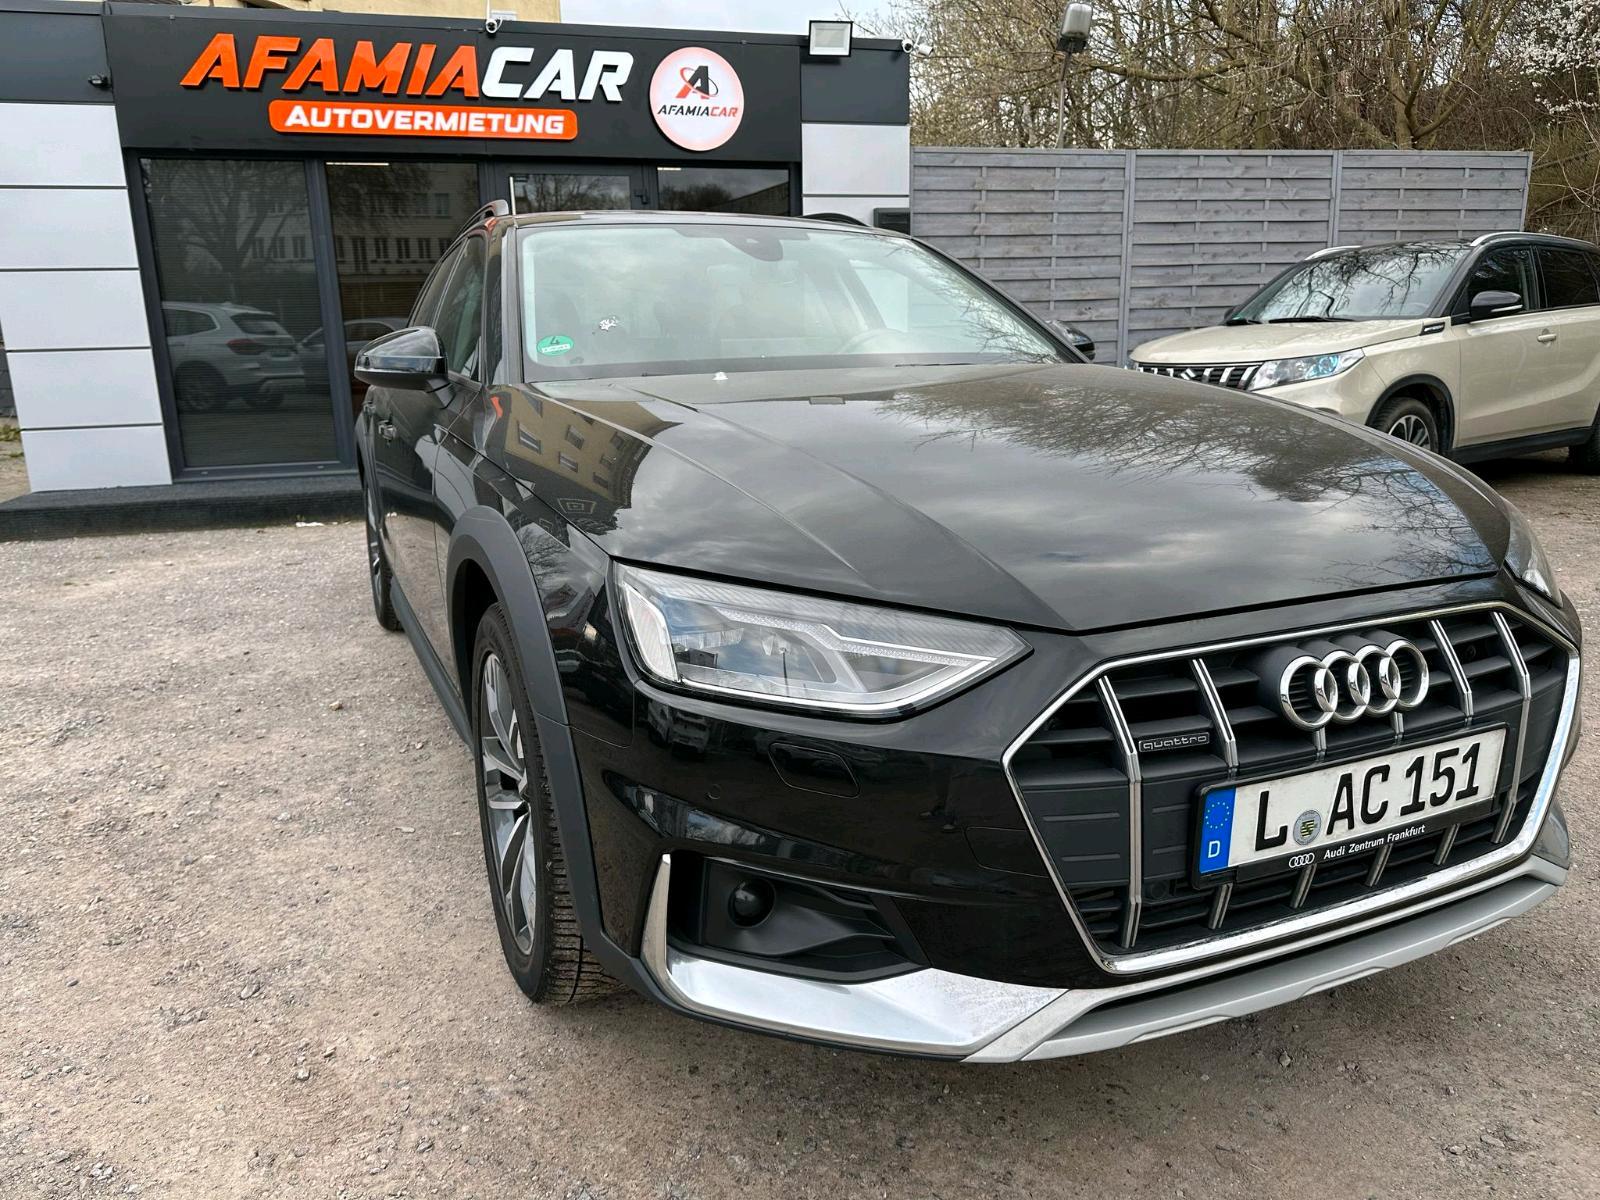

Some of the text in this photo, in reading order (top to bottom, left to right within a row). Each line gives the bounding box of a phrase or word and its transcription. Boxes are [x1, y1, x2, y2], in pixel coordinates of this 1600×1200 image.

[180, 33, 634, 102] AFAMIACAR
[284, 105, 564, 136] AUTOVERMIETUNG
[657, 104, 738, 118] AFAMIACAR
[1143, 735, 1207, 749] quattro
[1255, 742, 1481, 851] L AC 151
[1208, 841, 1220, 858] D
[1323, 824, 1426, 860] Audi Zentrum Frankfurt
